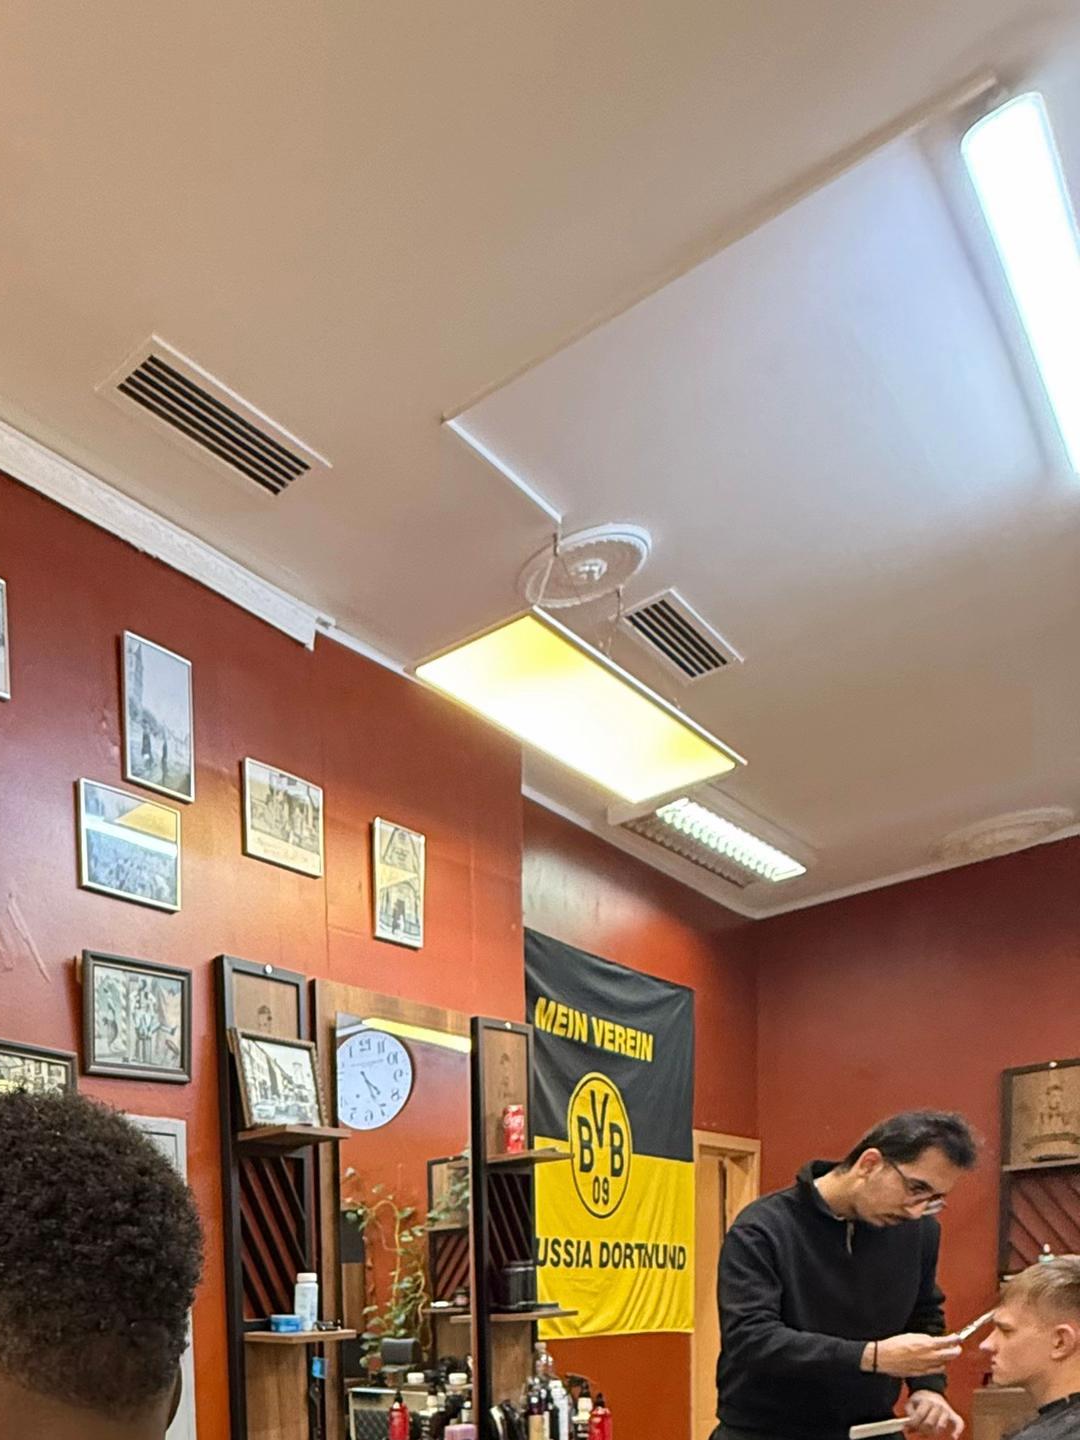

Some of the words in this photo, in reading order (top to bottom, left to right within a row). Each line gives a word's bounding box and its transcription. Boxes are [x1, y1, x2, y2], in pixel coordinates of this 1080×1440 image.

[535, 996, 588, 1044] MEIN
[591, 1016, 654, 1063] VEREIN
[577, 1089, 625, 1178] BVB
[592, 1175, 610, 1205] 09
